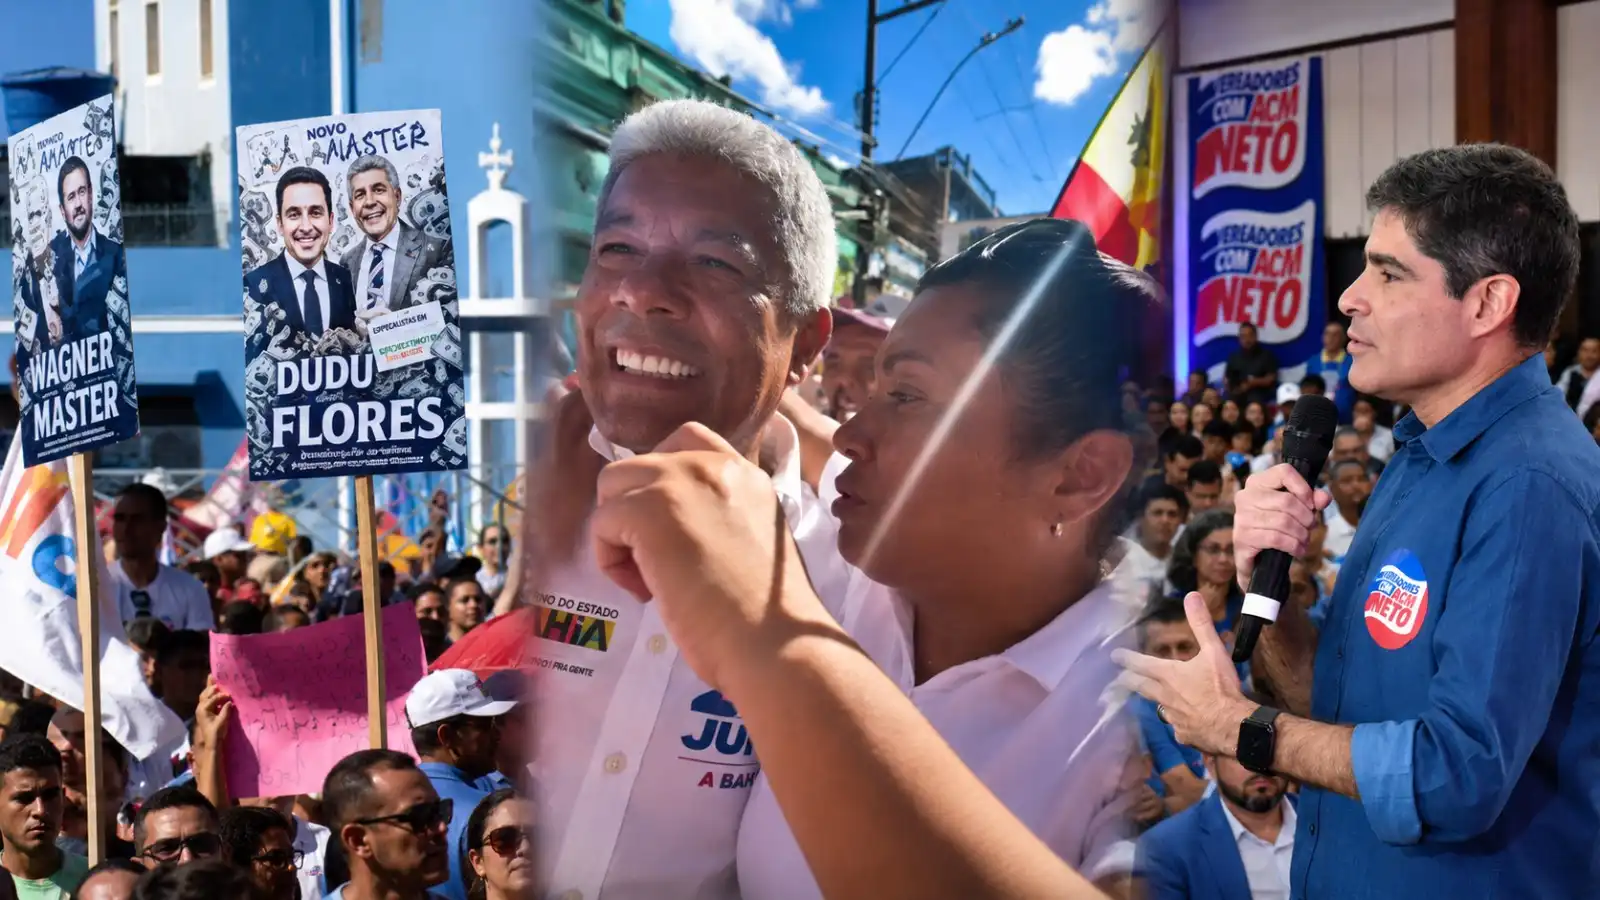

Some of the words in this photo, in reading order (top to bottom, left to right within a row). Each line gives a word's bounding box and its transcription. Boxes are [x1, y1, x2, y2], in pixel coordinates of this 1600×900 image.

[1212, 97, 1247, 122] COM
[1248, 84, 1299, 122] ACM
[307, 122, 347, 141] NOVO
[1194, 119, 1298, 189] NETO
[1209, 221, 1305, 246] VEREADORES
[1215, 249, 1250, 272] COM
[1252, 241, 1304, 278] ACM
[1194, 276, 1302, 335] NETO
[29, 331, 114, 393] WAGNER
[277, 354, 373, 396] DUDU
[34, 380, 119, 441] MASTER
[272, 397, 445, 448] FLORES
[558, 597, 575, 609] DO
[577, 601, 619, 619] ESTADO
[1364, 592, 1412, 627] NETO
[1391, 588, 1417, 608] ACM
[552, 661, 568, 672] PRA
[569, 665, 594, 677] GENTE
[697, 771, 714, 788] A
